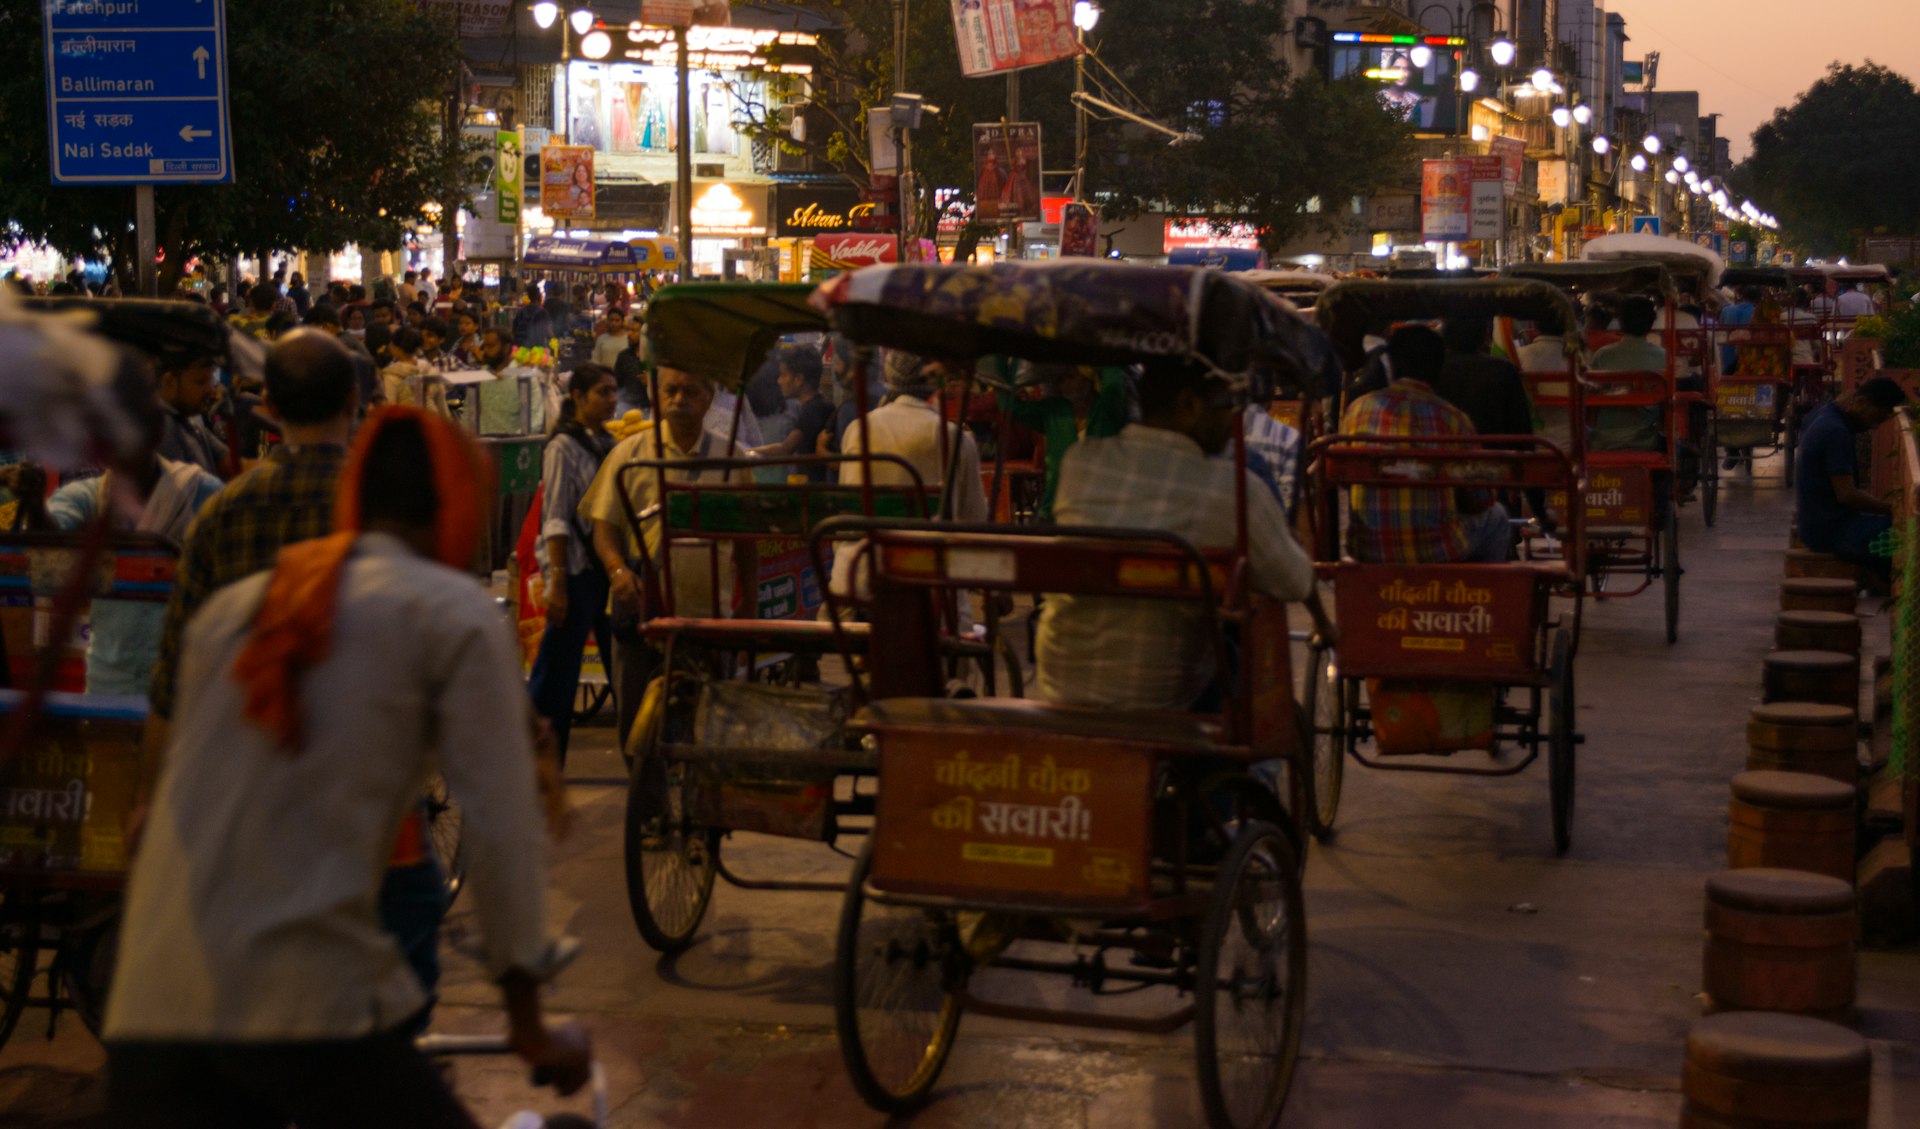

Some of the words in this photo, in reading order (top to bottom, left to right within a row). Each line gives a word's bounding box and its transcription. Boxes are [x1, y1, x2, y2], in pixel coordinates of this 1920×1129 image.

[55, 0, 139, 16] Fatehpuri
[61, 76, 154, 92] Ballimaran
[64, 110, 86, 129] नई
[93, 113, 134, 130] सड़क
[64, 142, 94, 158] Nai
[100, 142, 154, 158] Sadak
[786, 202, 843, 228] Asian
[829, 238, 891, 263] Vadilal
[1583, 488, 1622, 506] वारी!
[1445, 579, 1492, 604] चौक
[1377, 607, 1408, 631] की
[1411, 605, 1491, 635] सवारी!
[1027, 754, 1093, 793] चौक
[931, 795, 975, 832] की
[978, 795, 1092, 841] सवारी!
